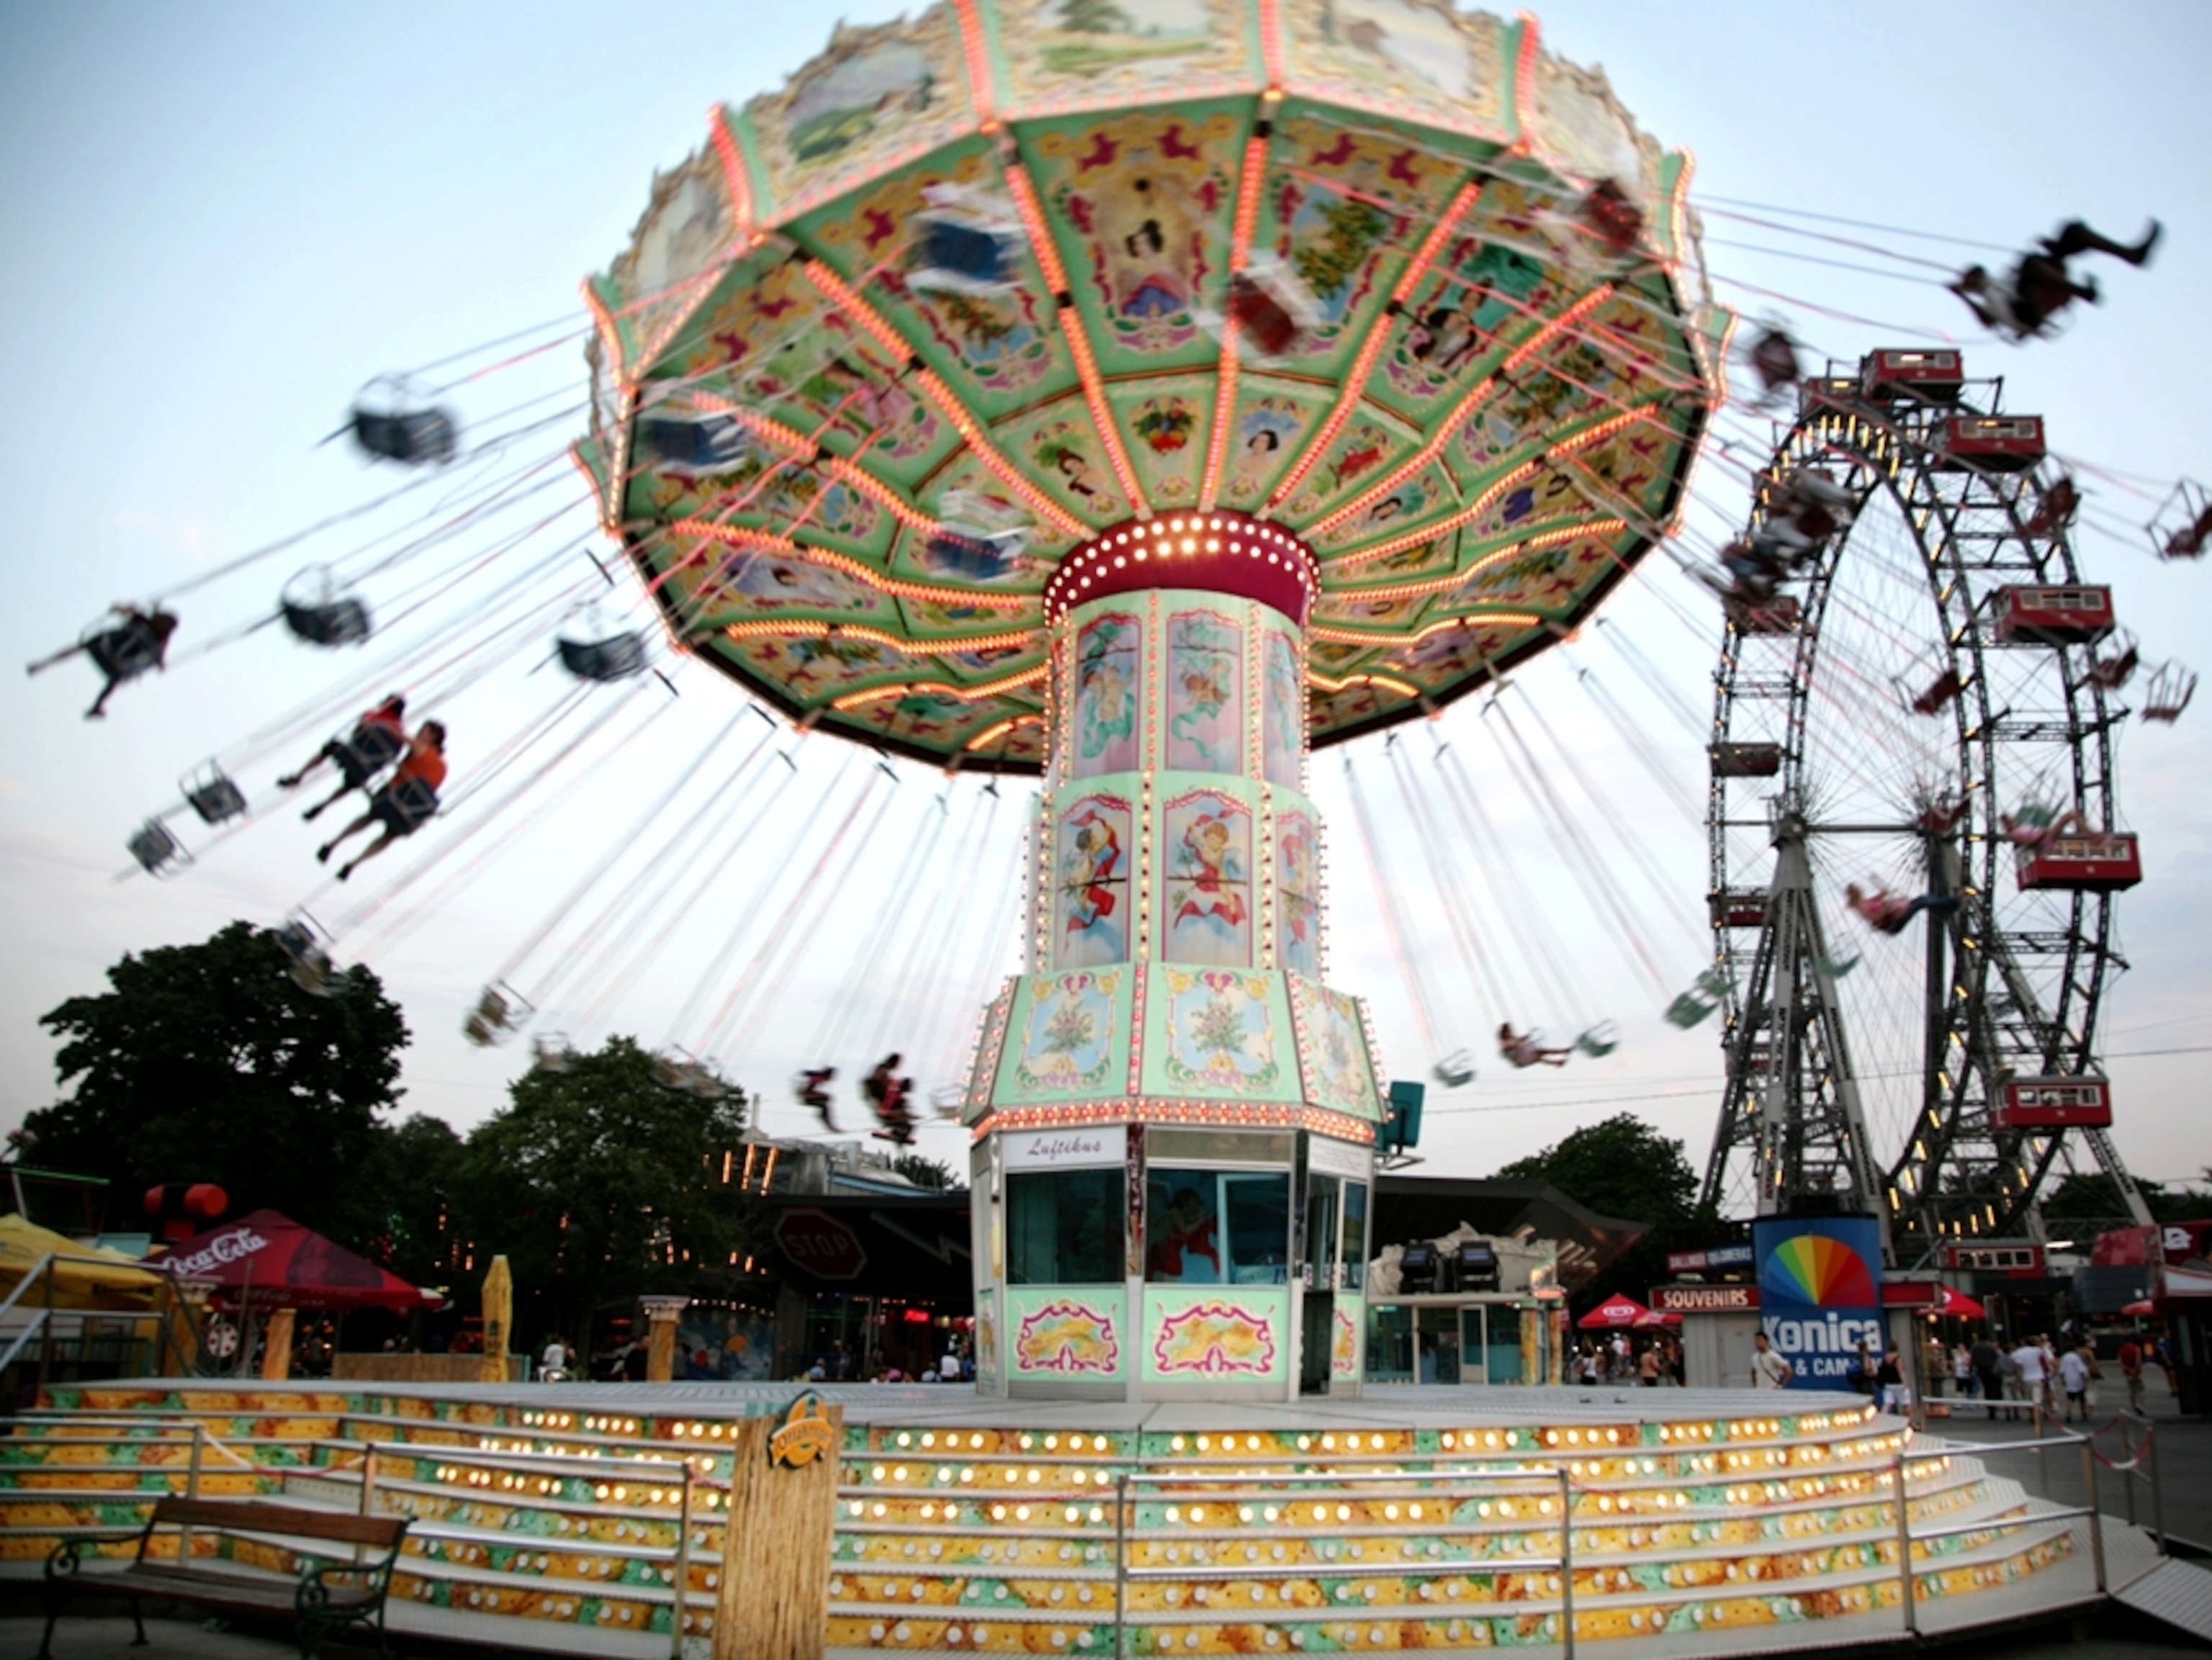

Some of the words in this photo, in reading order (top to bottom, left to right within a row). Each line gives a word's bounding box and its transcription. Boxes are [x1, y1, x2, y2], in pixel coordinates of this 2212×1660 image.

[1027, 1136, 1102, 1160] Luftikus
[786, 1235, 849, 1256] STOP
[1663, 1289, 1749, 1308] SOUVENIRS
[1762, 1312, 1882, 1353] Konica
